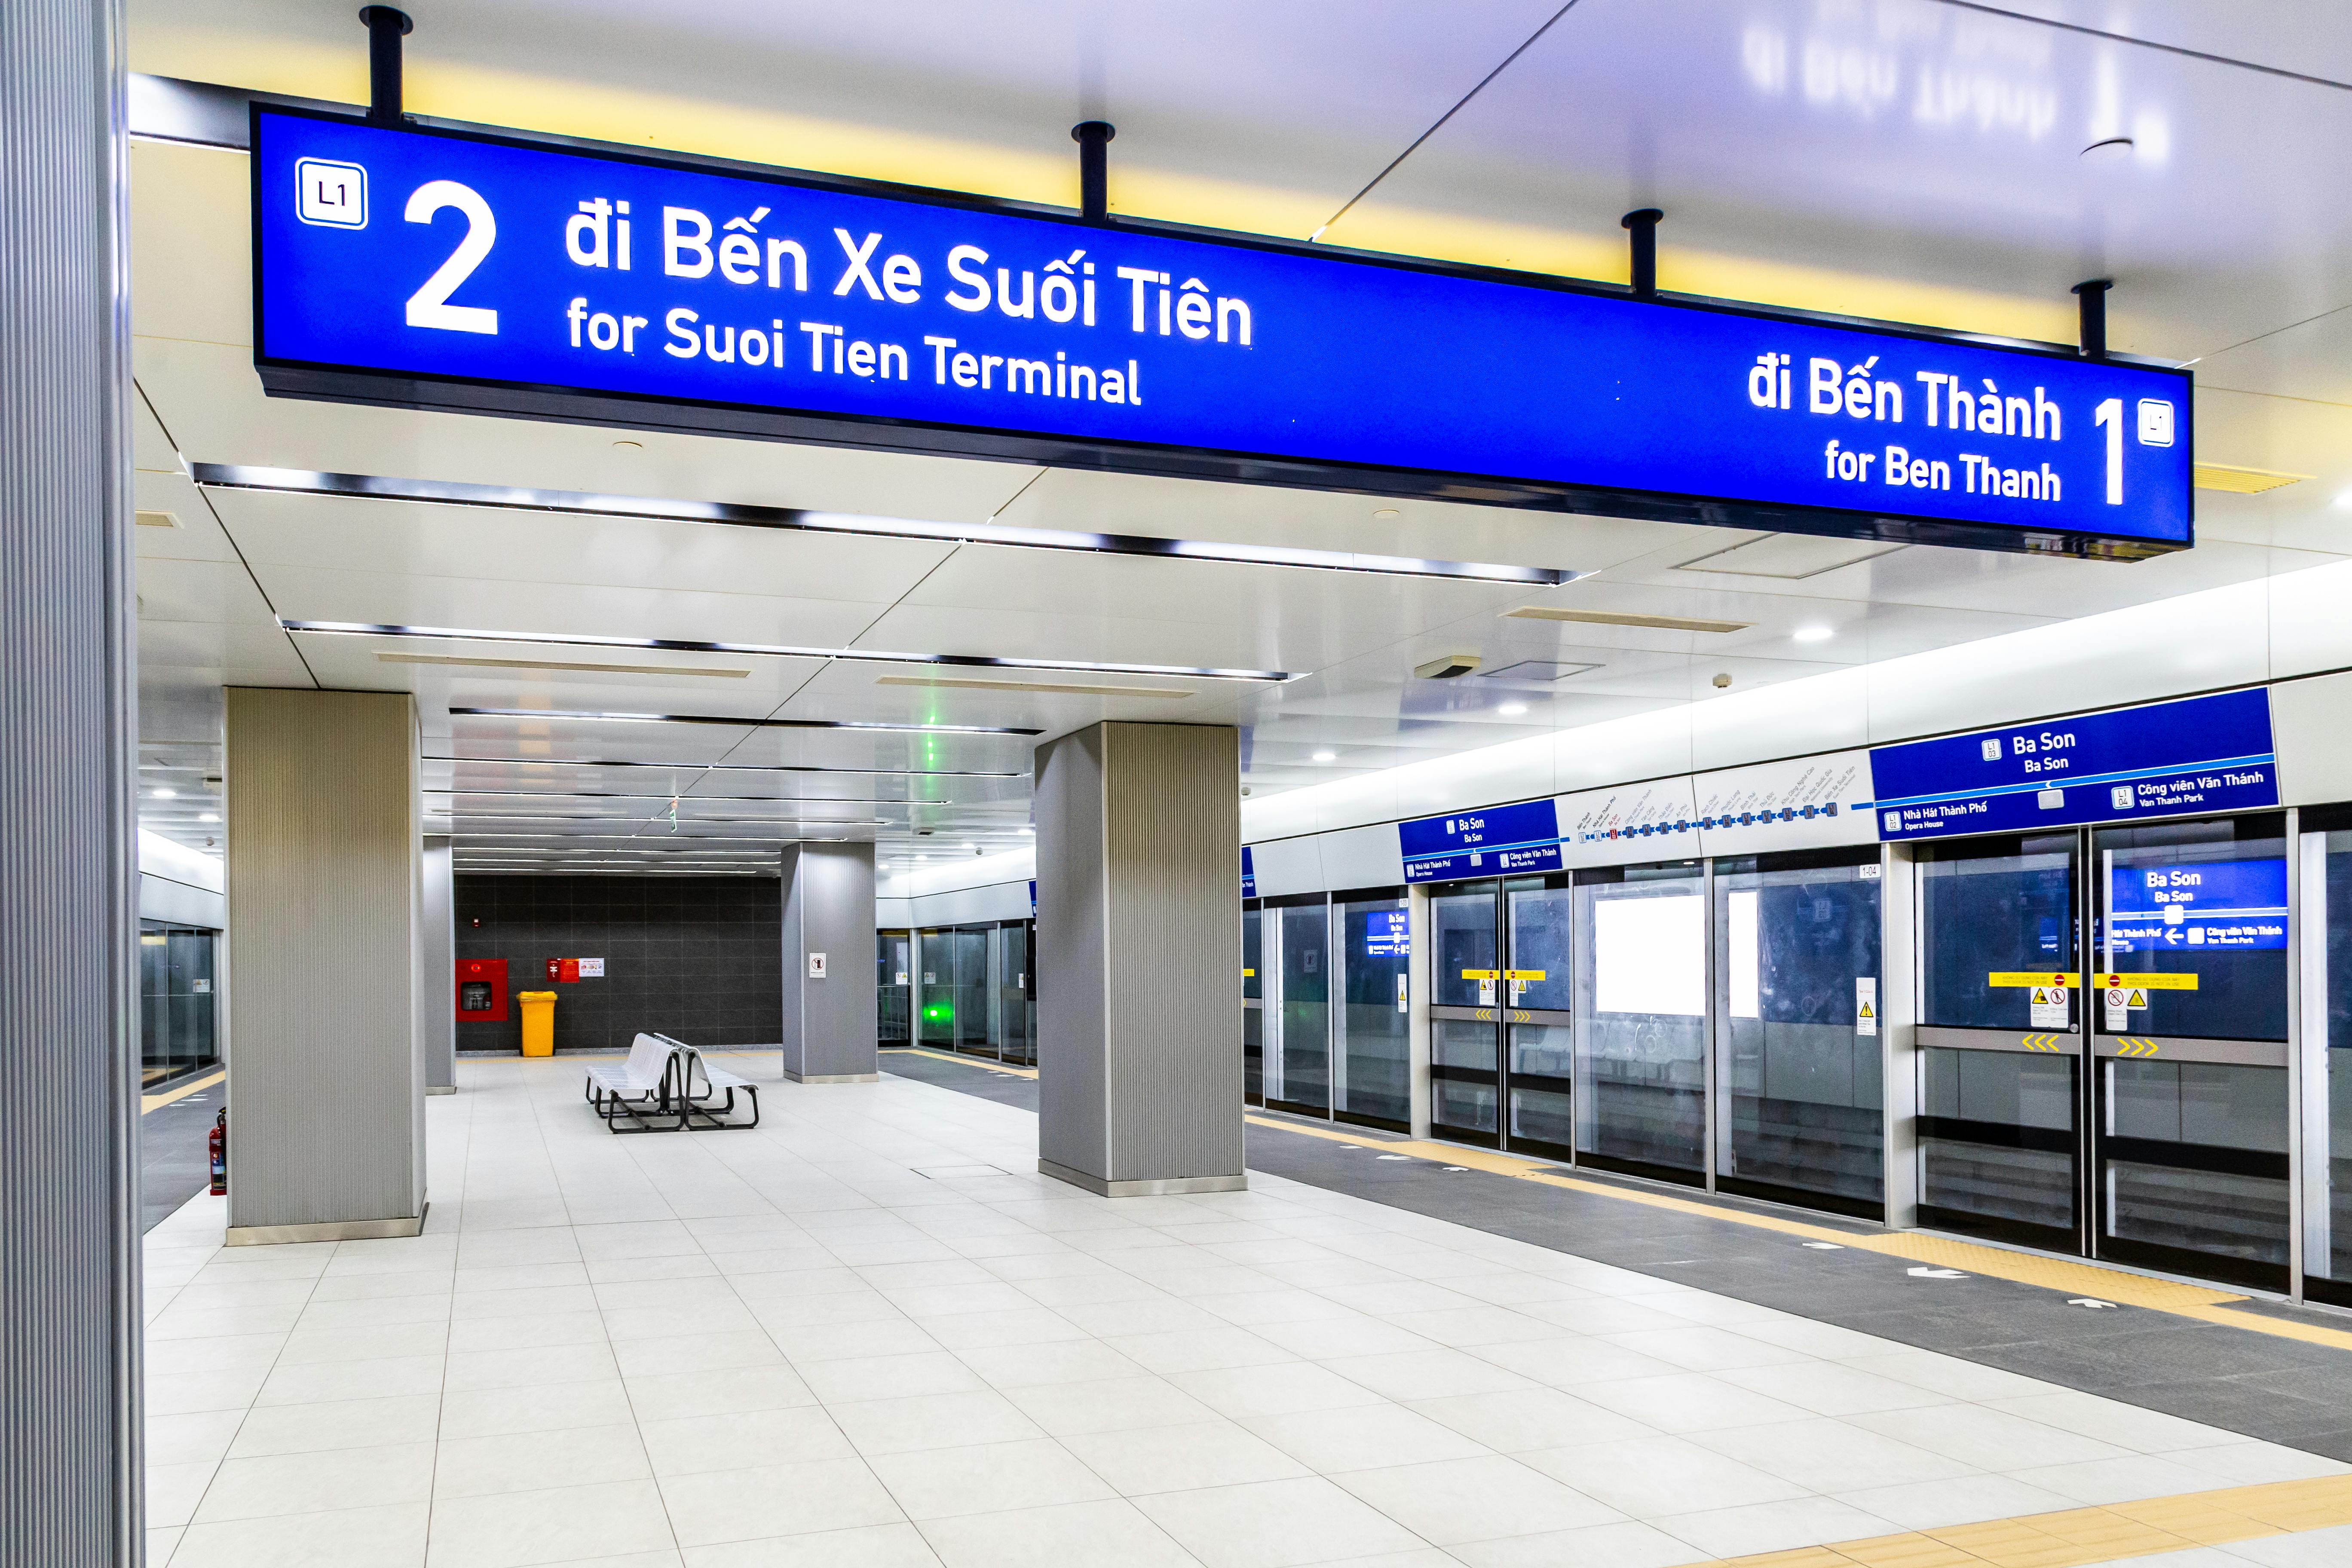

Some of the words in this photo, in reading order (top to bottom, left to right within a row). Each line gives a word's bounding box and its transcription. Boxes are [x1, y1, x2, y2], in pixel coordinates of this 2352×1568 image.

[319, 181, 344, 206] L1
[404, 180, 497, 334] 2
[566, 198, 630, 270] đi
[663, 206, 807, 291] Bến
[833, 228, 921, 303] Xe
[945, 245, 1095, 326] Suối
[1117, 266, 1251, 345] Tiên
[567, 297, 648, 352] for
[664, 308, 783, 368] Suoi
[800, 322, 907, 379] Tien
[924, 336, 1141, 405] Terminal
[1749, 352, 1790, 409] đi
[1810, 356, 1902, 422] Bến
[1917, 371, 2061, 441] Thành
[2095, 398, 2123, 505] 1
[1825, 440, 1876, 481] for
[1886, 446, 1950, 490] Ben
[1959, 453, 2061, 501] Thanh
[2013, 737, 2036, 754] Ba
[2041, 732, 2075, 750] Son
[2025, 760, 2041, 772] Ba
[2044, 757, 2068, 770] Son
[2138, 784, 2167, 796] Công
[2170, 780, 2194, 791] viên
[2197, 777, 2220, 788] Văn
[2223, 772, 2263, 786] Thánh
[2118, 790, 2127, 798] L1
[2118, 798, 2128, 806] 04
[2156, 796, 2182, 805] Thanh
[2184, 794, 2203, 802] Park
[1904, 809, 1921, 820] Nhà
[1923, 808, 1937, 818] Hát
[1939, 805, 1966, 816] Thành
[1969, 801, 1987, 813] Phố
[1459, 820, 1469, 830] Ba
[1470, 818, 1484, 829] Son
[1472, 833, 1482, 842] Son
[1510, 853, 1522, 861] Công
[1541, 848, 1556, 857] Thánh
[1862, 866, 1877, 876] 1-04
[2147, 871, 2167, 887] Ba
[2170, 871, 2202, 886] Son
[2155, 891, 2170, 903] Ba
[2171, 891, 2194, 902] Son
[2146, 928, 2162, 937] Phố
